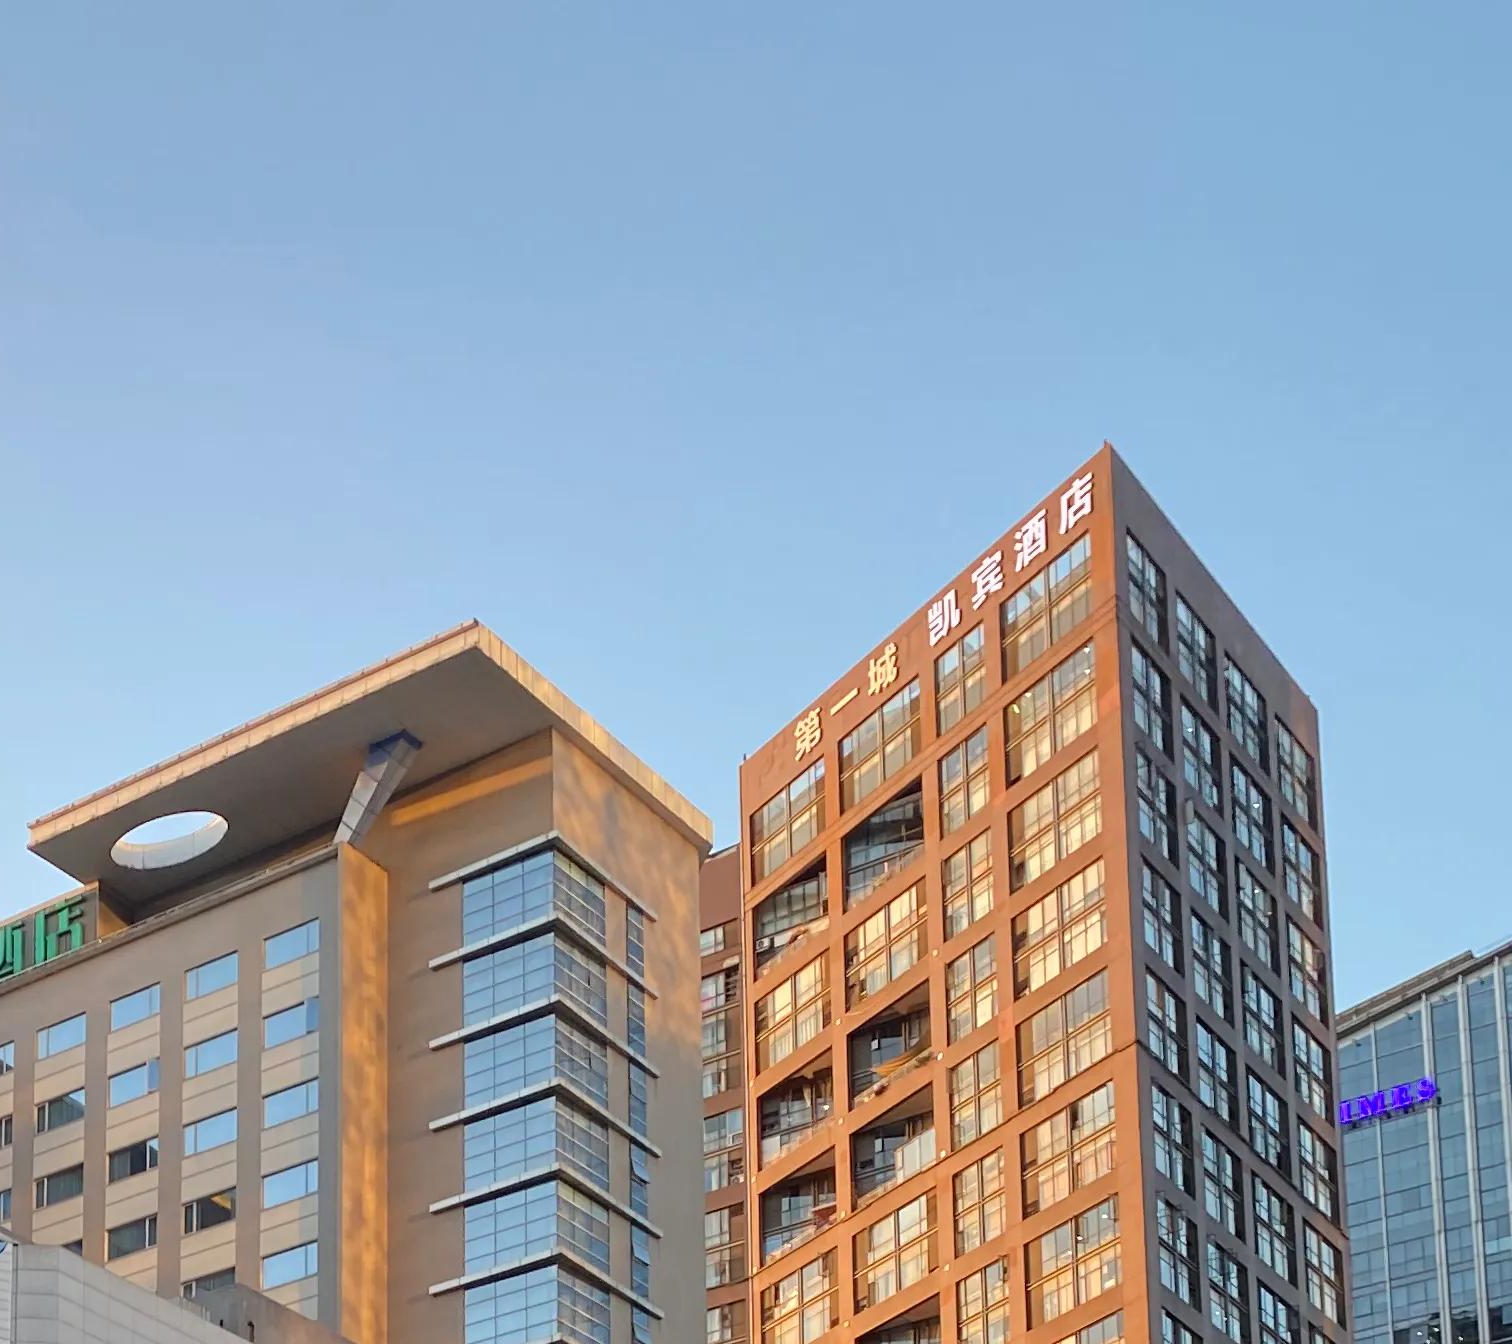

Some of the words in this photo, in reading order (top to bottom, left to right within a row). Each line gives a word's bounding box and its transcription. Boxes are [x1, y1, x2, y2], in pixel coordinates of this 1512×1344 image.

[793, 643, 898, 761] 第一城
[927, 471, 1094, 647] 凯宾酒店
